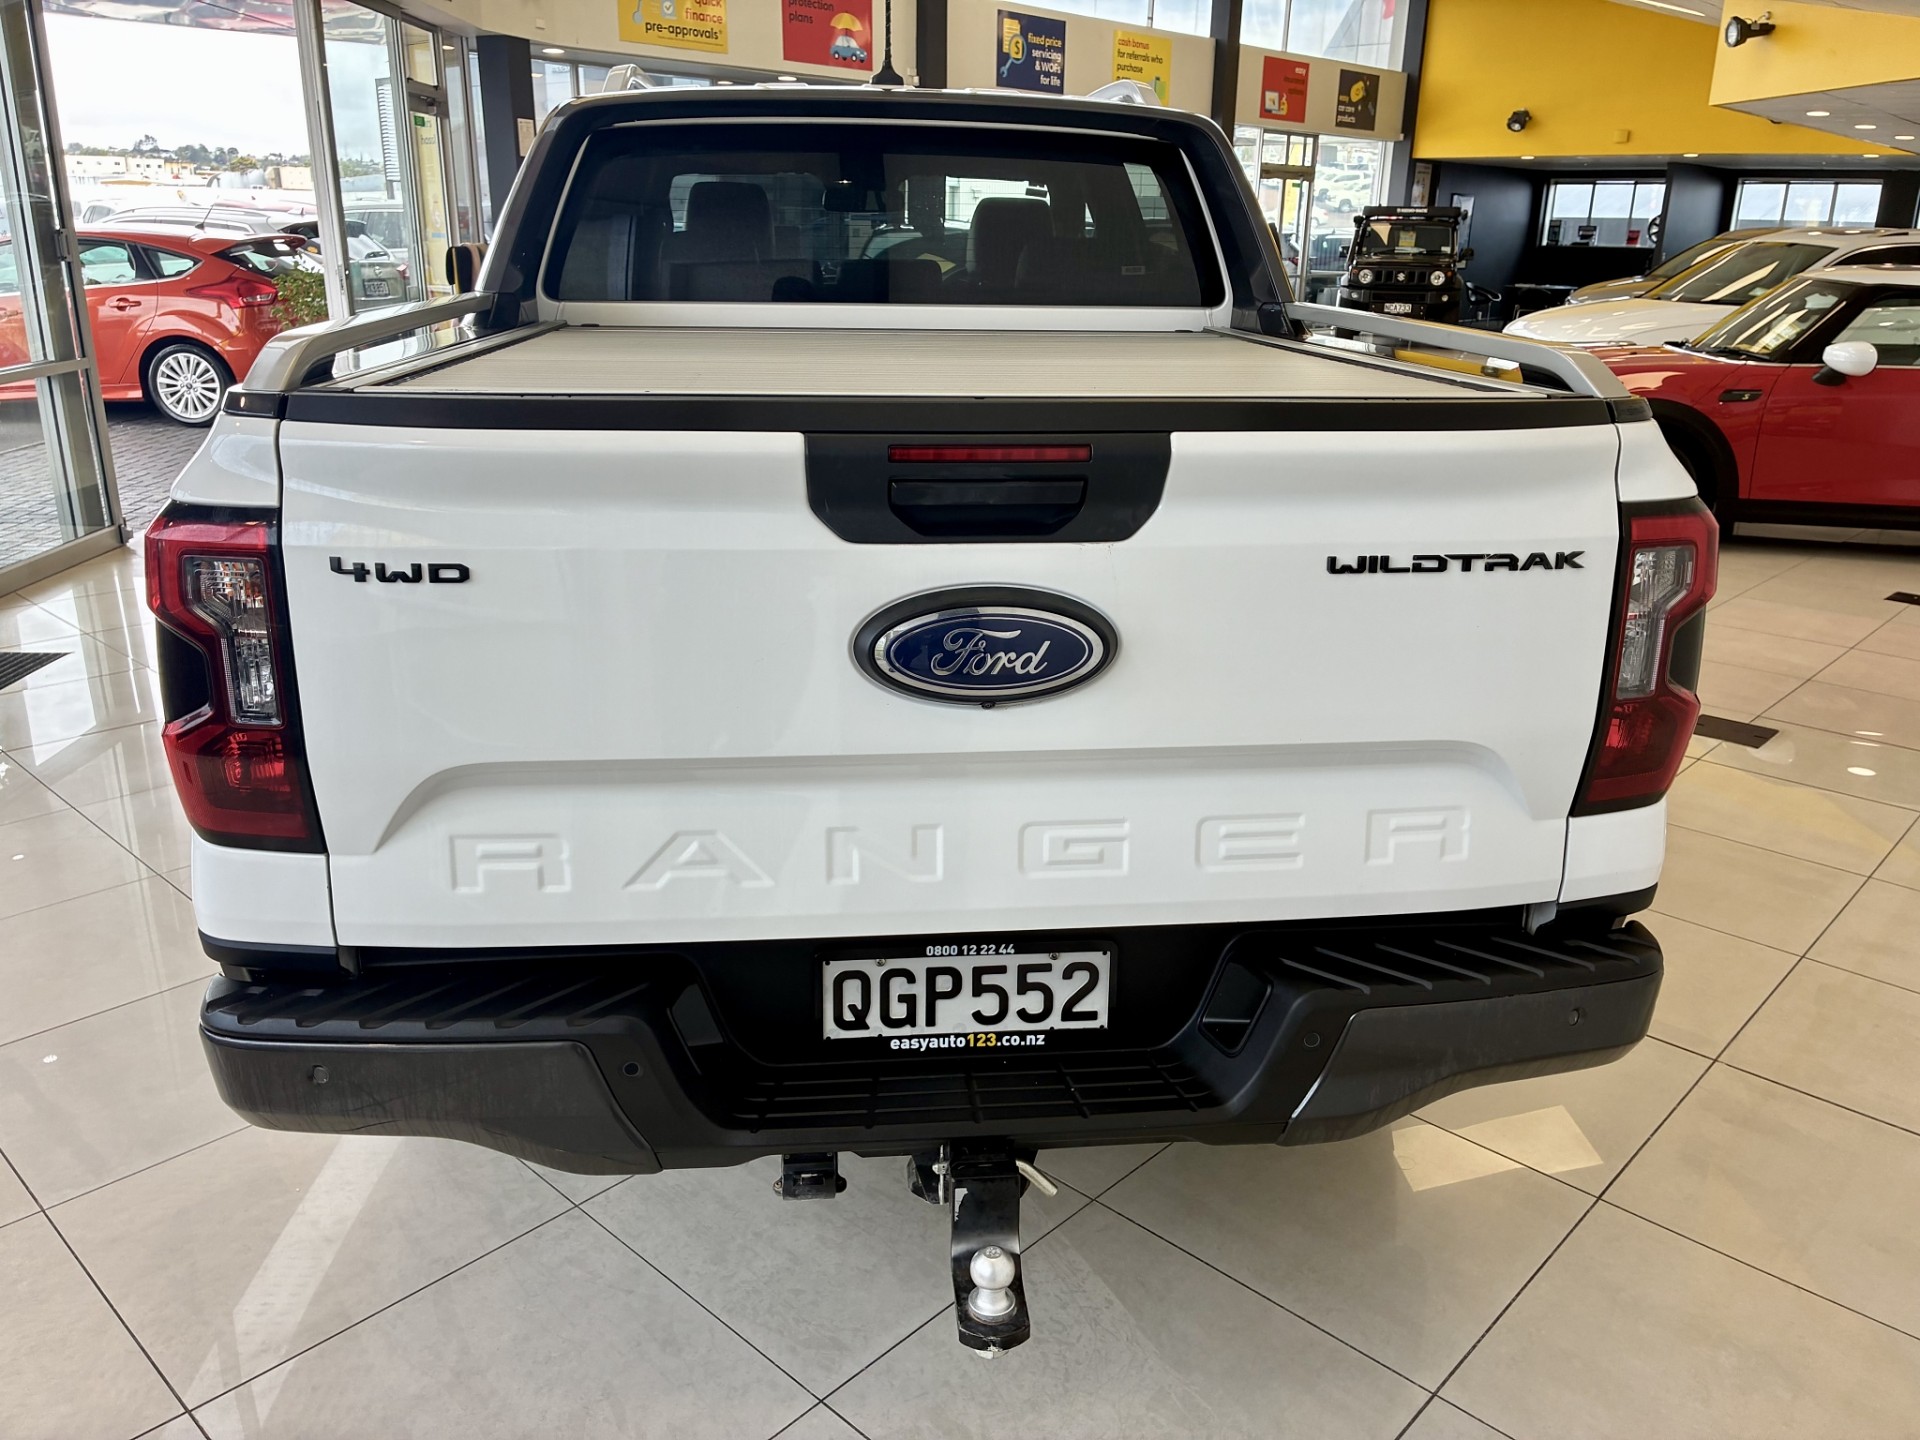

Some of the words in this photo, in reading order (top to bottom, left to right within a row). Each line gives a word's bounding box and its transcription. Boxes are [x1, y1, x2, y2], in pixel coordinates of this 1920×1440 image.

[695, 0, 722, 8] quick
[789, 0, 834, 11] protection
[685, 8, 723, 24] finance
[789, 10, 813, 24] plans
[1028, 33, 1045, 45] fixed
[1045, 36, 1062, 48] price
[1118, 38, 1132, 47] cash
[1132, 40, 1150, 50] bonus
[1031, 48, 1062, 63] servicing
[1117, 48, 1126, 58] for
[1126, 49, 1150, 63] referrals
[1151, 54, 1163, 64] who
[1035, 60, 1041, 71] &
[1117, 63, 1143, 74] purchase
[1040, 74, 1050, 85] for
[1050, 75, 1061, 87] life
[329, 555, 471, 584] 4WD
[1326, 550, 1586, 576] WILDTRAK
[931, 627, 1051, 676] Ford
[449, 806, 1472, 894] RANGER
[926, 945, 958, 956] 0800
[961, 944, 977, 955] 12
[979, 944, 996, 955] 22
[998, 943, 1015, 955] 44
[832, 961, 1100, 1031] QGP552
[890, 1033, 1046, 1052] easyauto123.co.nz
